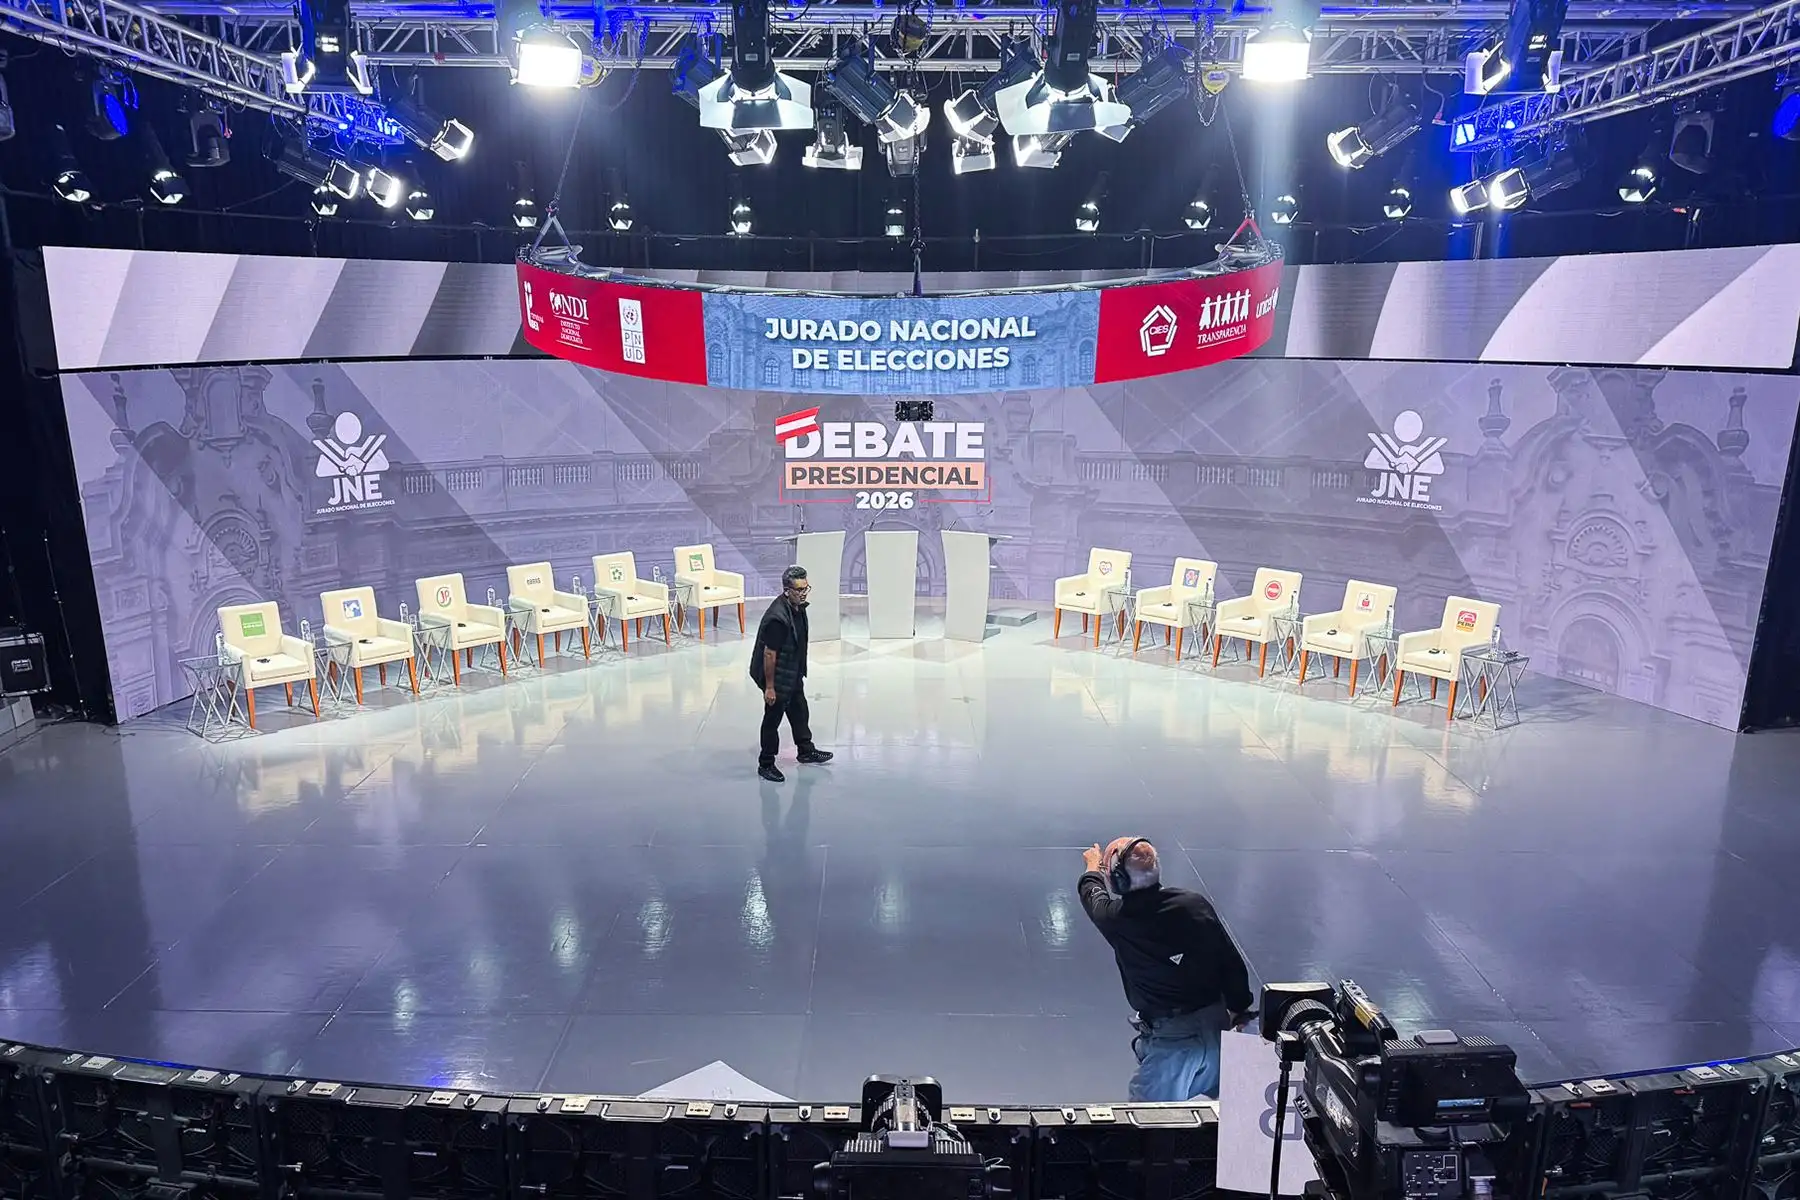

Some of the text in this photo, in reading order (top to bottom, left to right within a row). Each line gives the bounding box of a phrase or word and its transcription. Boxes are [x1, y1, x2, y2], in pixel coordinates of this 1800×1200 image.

[560, 294, 589, 320] NDI
[764, 316, 1036, 342] JURADO NACIONAL
[1149, 324, 1169, 336] CIES
[1197, 324, 1248, 344] TRANSPARENCIA
[792, 346, 1010, 371] DE ELECCIONES
[785, 422, 986, 458] DEBATE
[791, 466, 979, 486] PRESIDENCIAL
[1371, 472, 1432, 502] JNE
[327, 474, 383, 505] JNE
[855, 491, 915, 510] 2026
[316, 506, 336, 515] JURADO
[335, 504, 360, 512] NACIONAL
[366, 499, 396, 508] ELECCIONES
[1356, 497, 1377, 505] JURADO
[1377, 498, 1402, 507] NACIONAL
[1411, 502, 1442, 511] ELECCIONES
